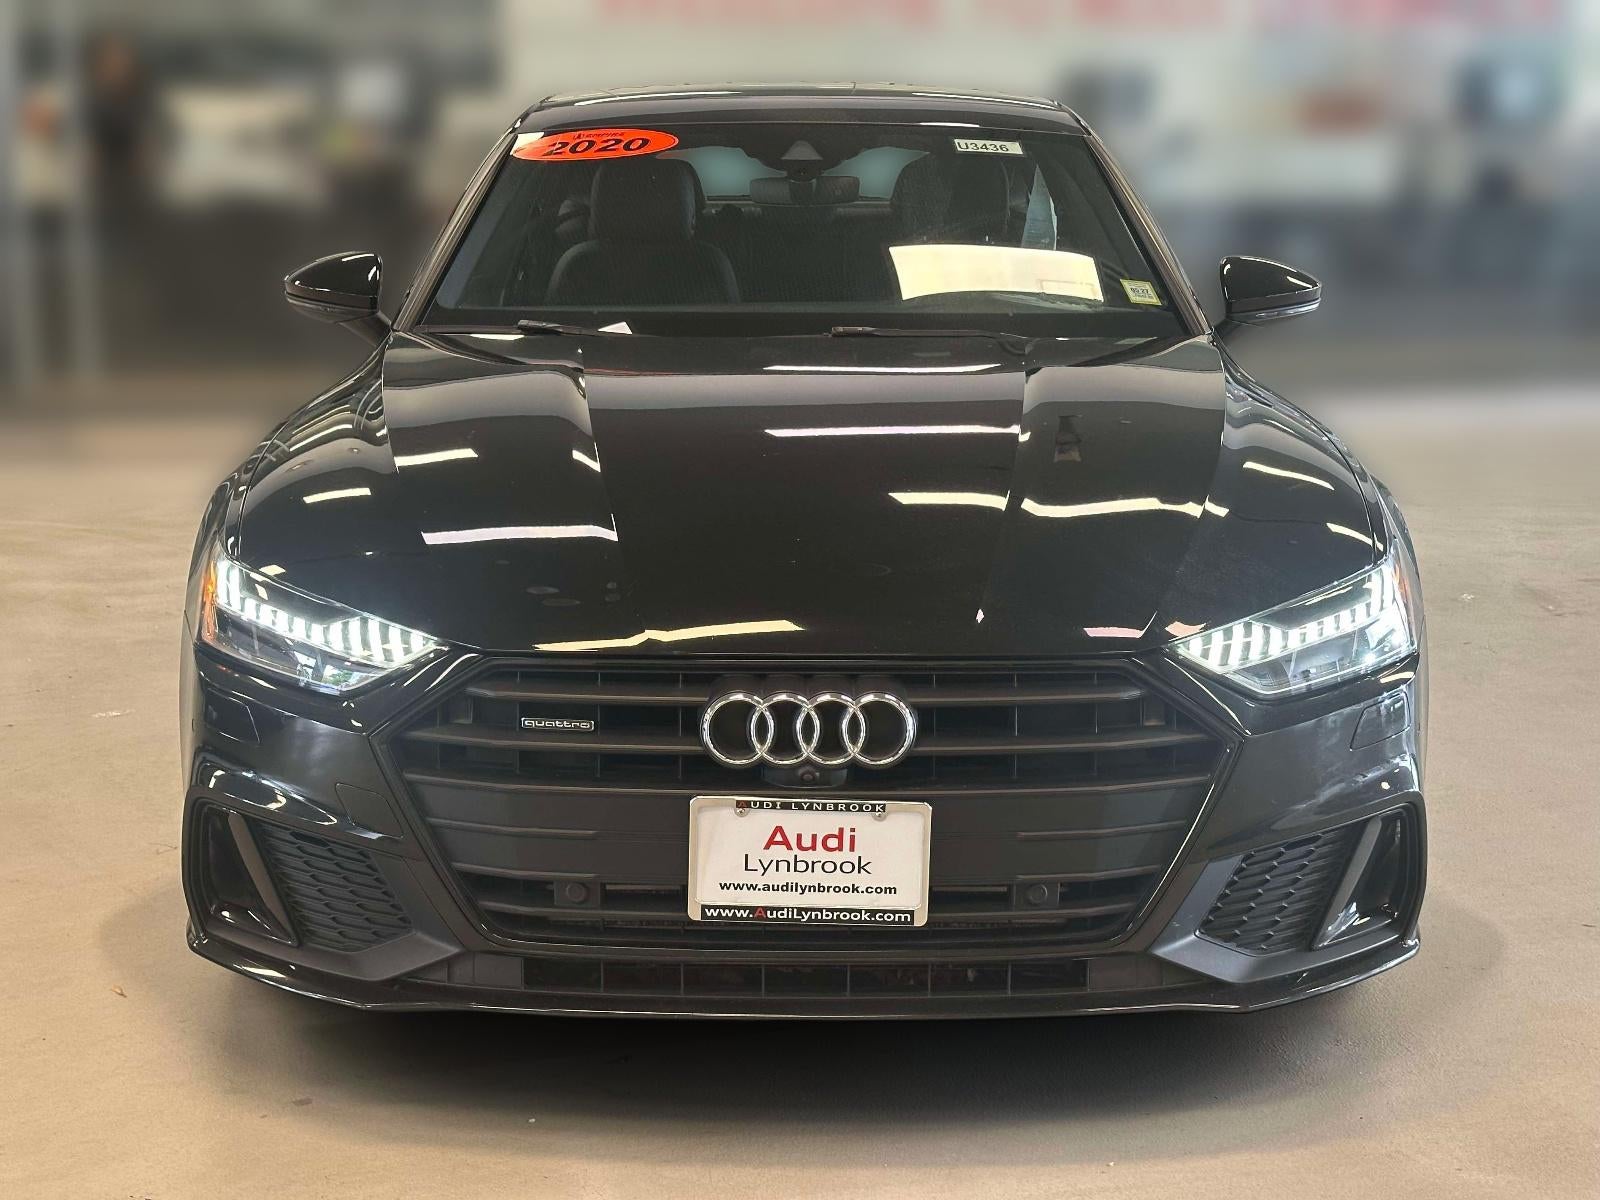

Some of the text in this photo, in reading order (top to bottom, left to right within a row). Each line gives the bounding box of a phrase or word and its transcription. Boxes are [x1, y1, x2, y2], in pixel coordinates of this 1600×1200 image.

[543, 137, 651, 156] 2020
[957, 142, 1009, 151] U3436
[525, 720, 591, 729] quattro
[738, 800, 884, 812] AUDI LYNBROOK
[763, 825, 856, 852] Audi
[744, 853, 872, 876] Lynbrook
[719, 881, 897, 895] www.audilynbrook.com
[704, 906, 912, 922] www.AudiLynbrook.com
